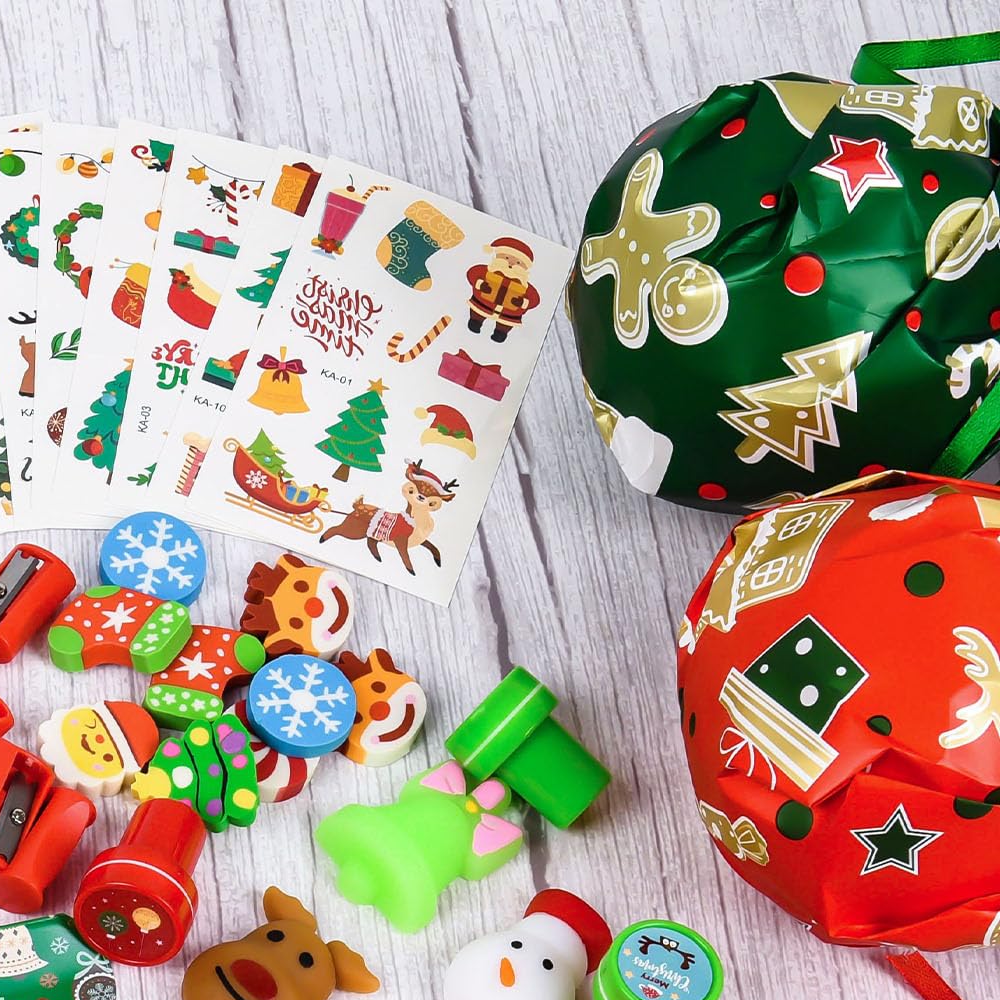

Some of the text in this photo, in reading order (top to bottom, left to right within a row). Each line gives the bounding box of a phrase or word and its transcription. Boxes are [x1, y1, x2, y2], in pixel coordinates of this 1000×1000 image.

[320, 368, 353, 386] KA-01
[193, 394, 227, 413] KA-10
[137, 405, 152, 434] KA-03
[632, 956, 690, 991] Christmas
[641, 972, 669, 989] Merry
